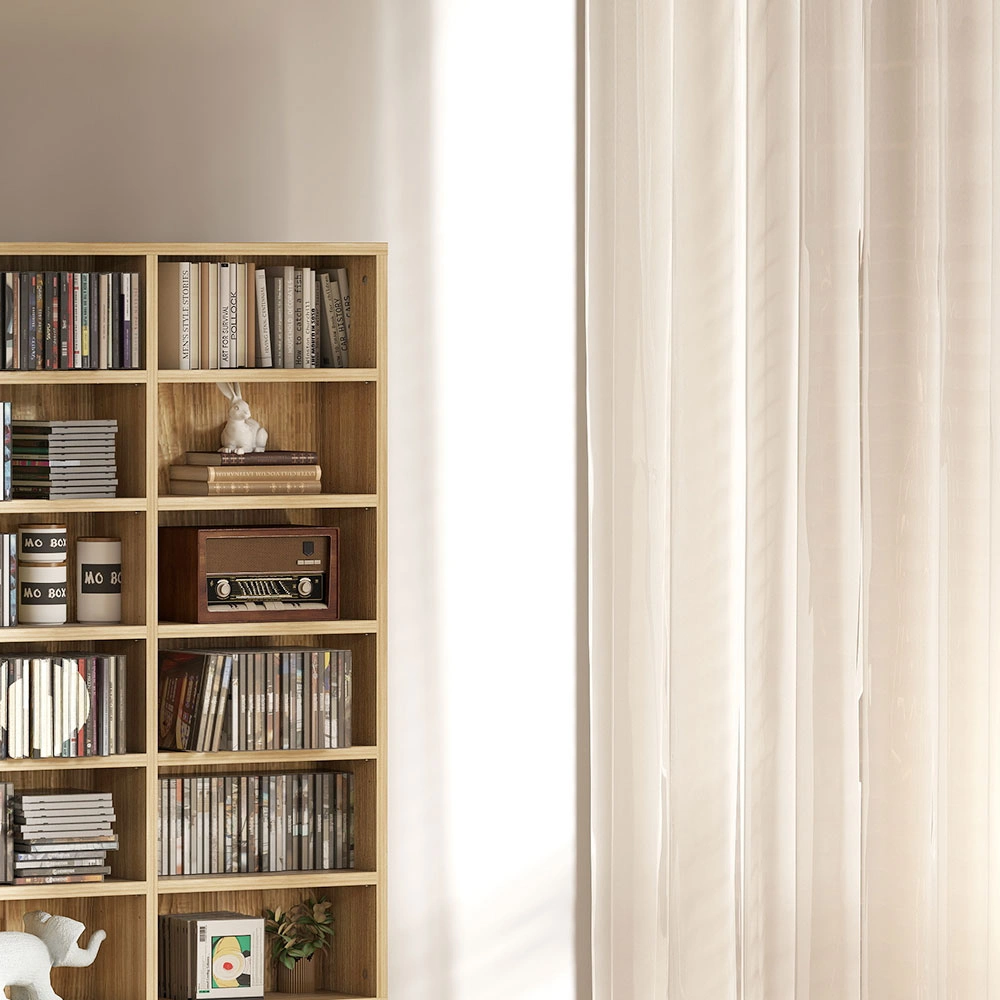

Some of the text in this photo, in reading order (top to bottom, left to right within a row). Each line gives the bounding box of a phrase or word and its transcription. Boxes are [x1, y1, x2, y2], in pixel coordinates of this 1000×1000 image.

[334, 298, 347, 351] CAR HISTORY
[296, 336, 301, 345] to
[24, 538, 43, 548] MO
[84, 572, 103, 584] MO
[24, 588, 66, 598] MO BOX
